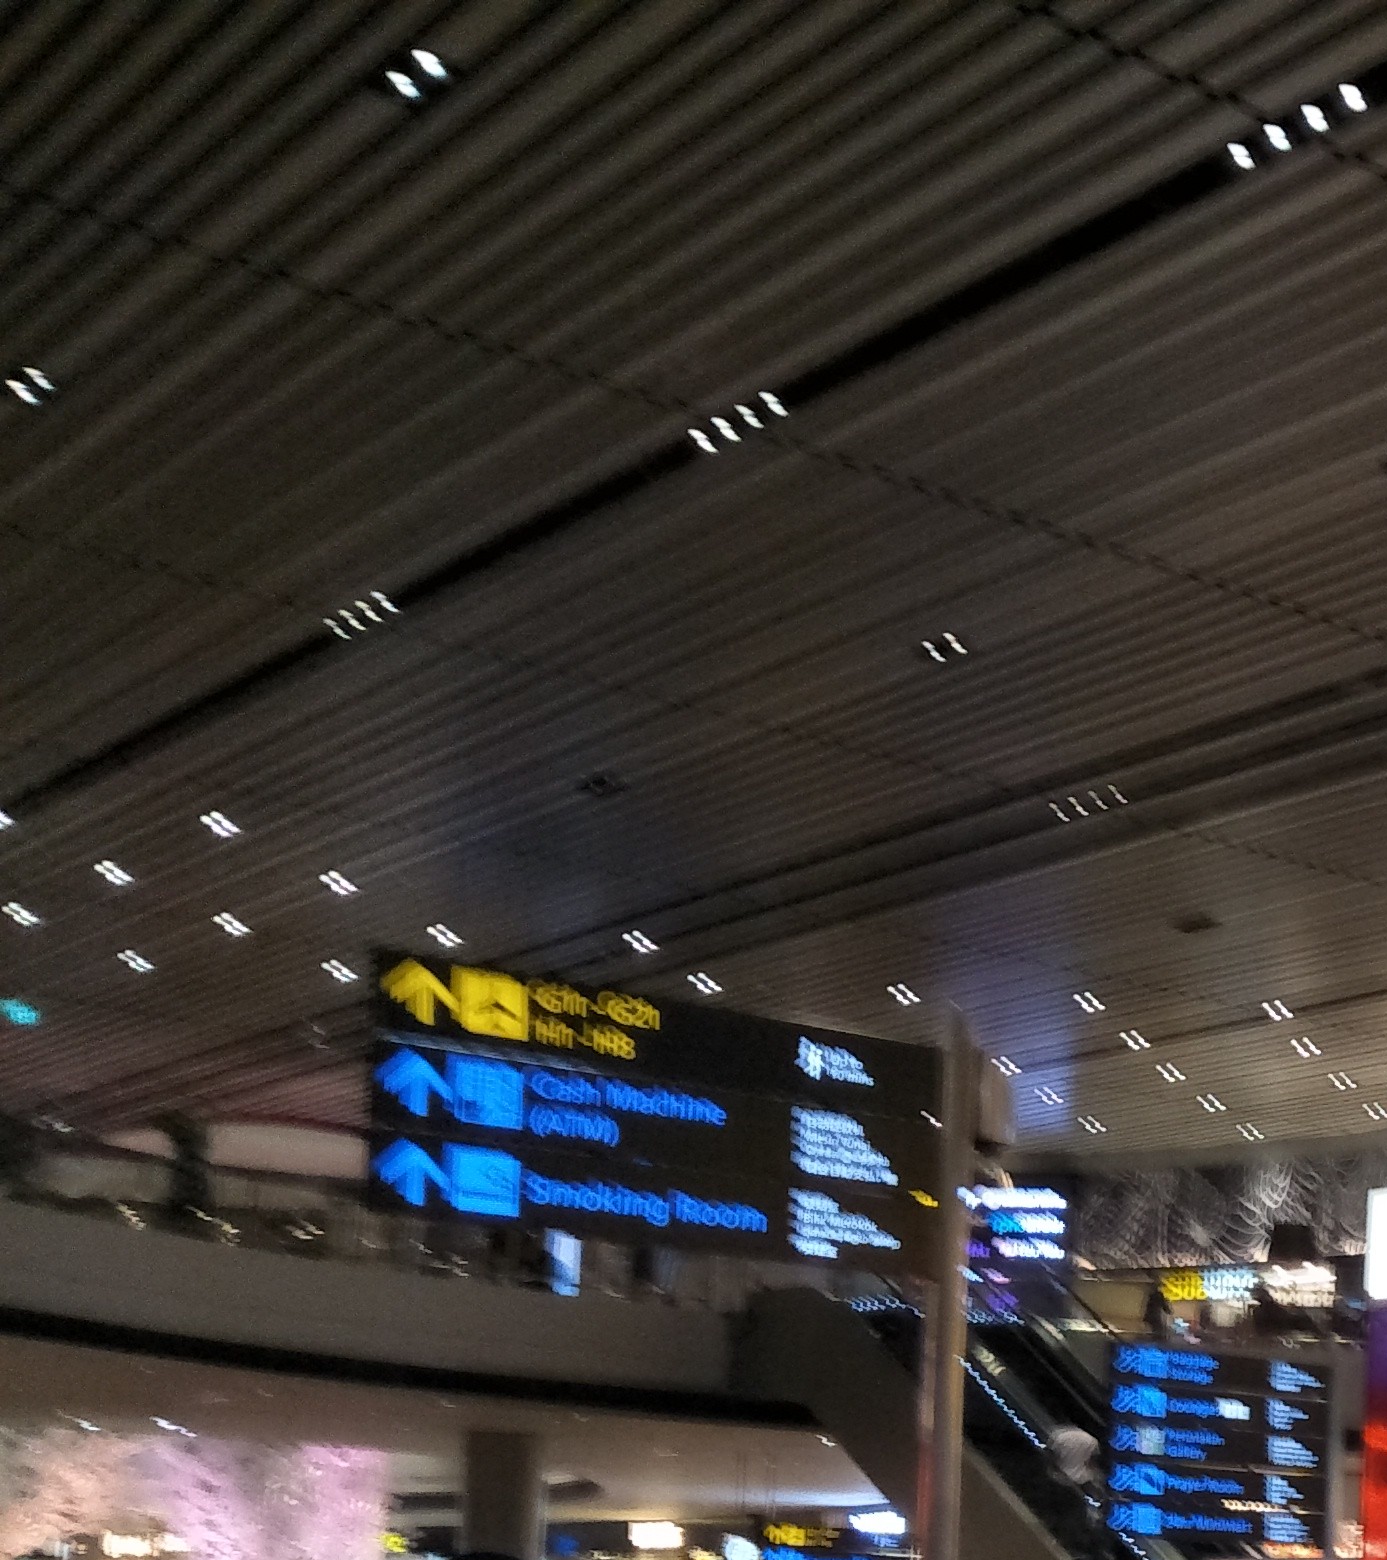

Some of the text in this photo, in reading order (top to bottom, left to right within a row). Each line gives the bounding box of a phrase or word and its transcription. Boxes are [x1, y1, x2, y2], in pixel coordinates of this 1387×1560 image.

[524, 1066, 727, 1127] Cash Machine
[527, 1103, 621, 1147] (ATM)
[521, 1168, 670, 1228] Smoking
[667, 1188, 768, 1233] Room
